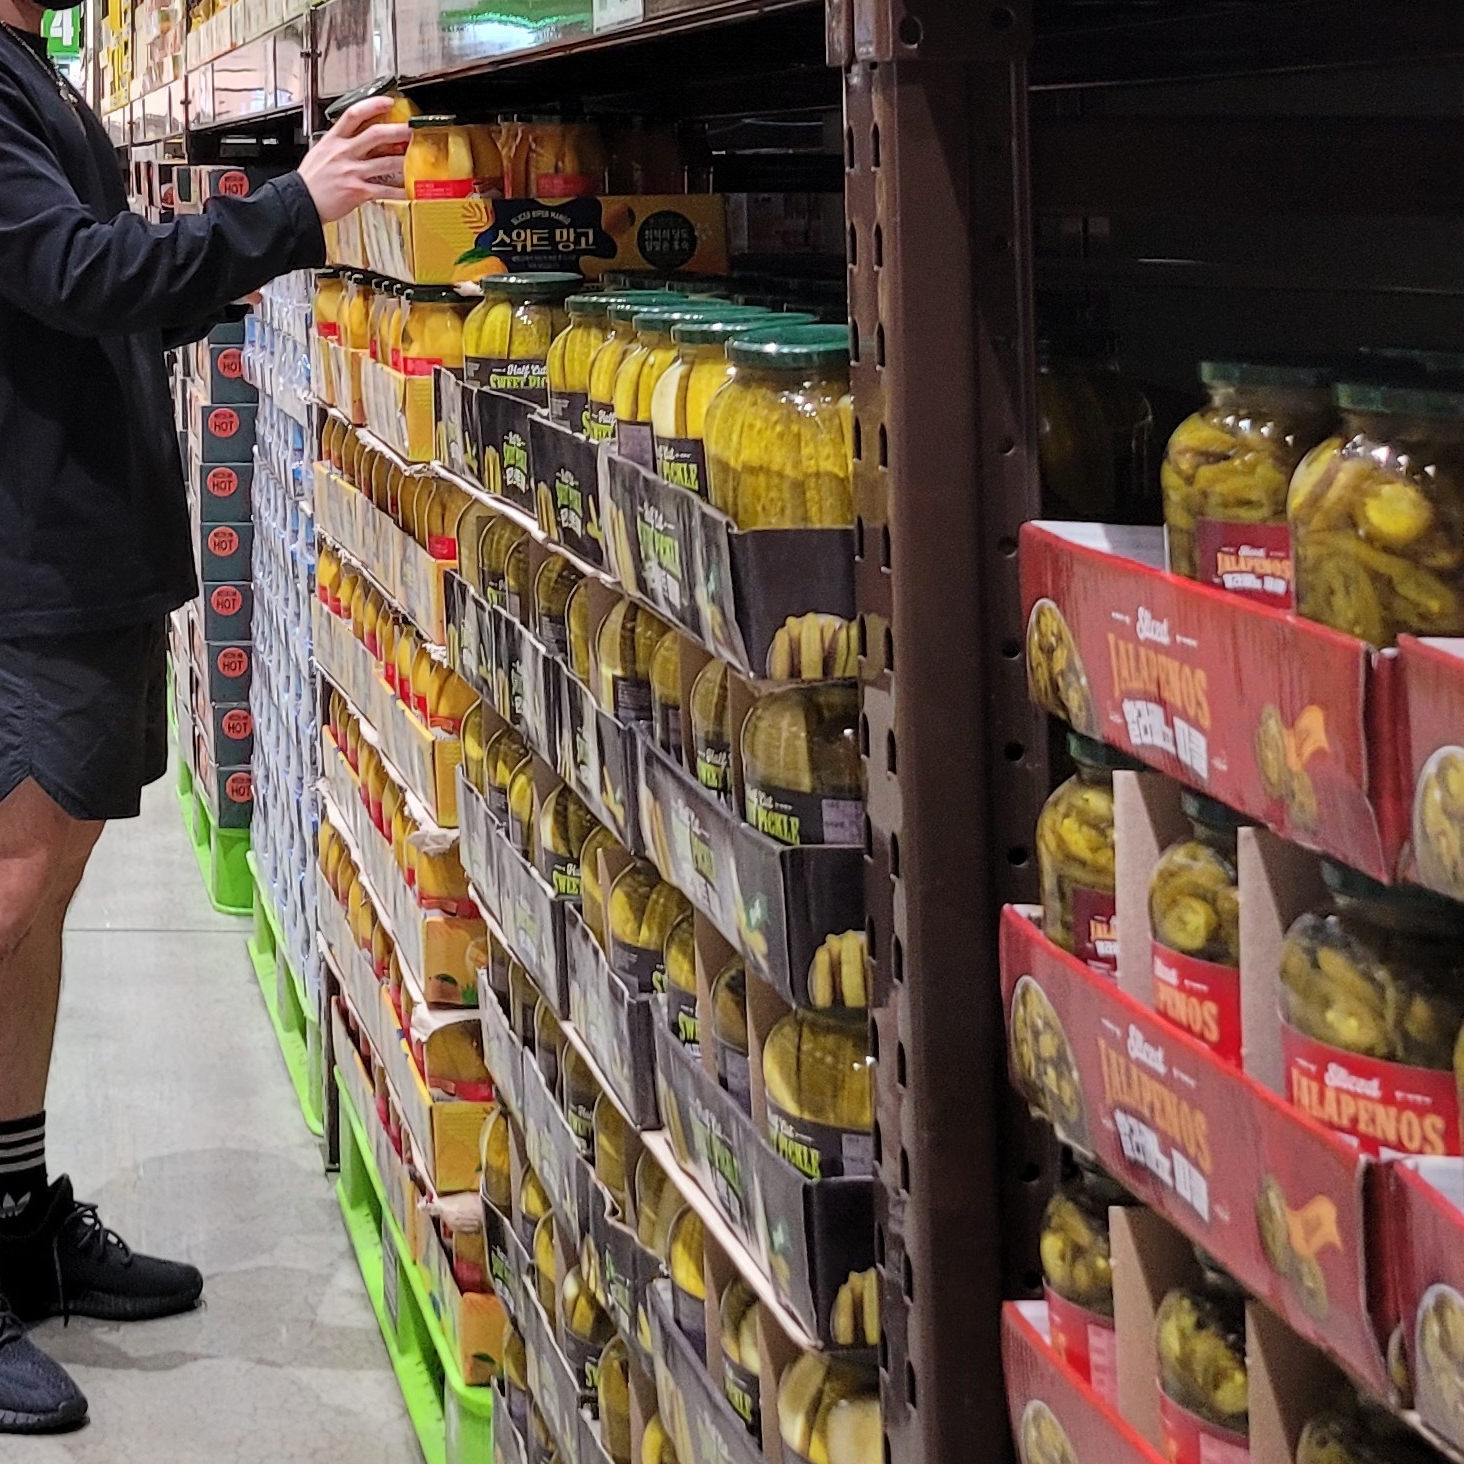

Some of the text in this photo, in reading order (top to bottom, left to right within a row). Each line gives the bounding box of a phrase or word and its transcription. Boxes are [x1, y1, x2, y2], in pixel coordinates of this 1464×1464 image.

[491, 228, 597, 252] 스위트 망고
[214, 421, 234, 432] HOT
[212, 480, 233, 492] HOT
[213, 539, 234, 551] HOT
[216, 598, 237, 610] HOT
[1136, 605, 1171, 647] Sliced
[222, 660, 243, 672] HOT
[227, 722, 248, 734] HOT
[1127, 1023, 1168, 1076] Sliced
[1324, 1061, 1382, 1099] Sliced
